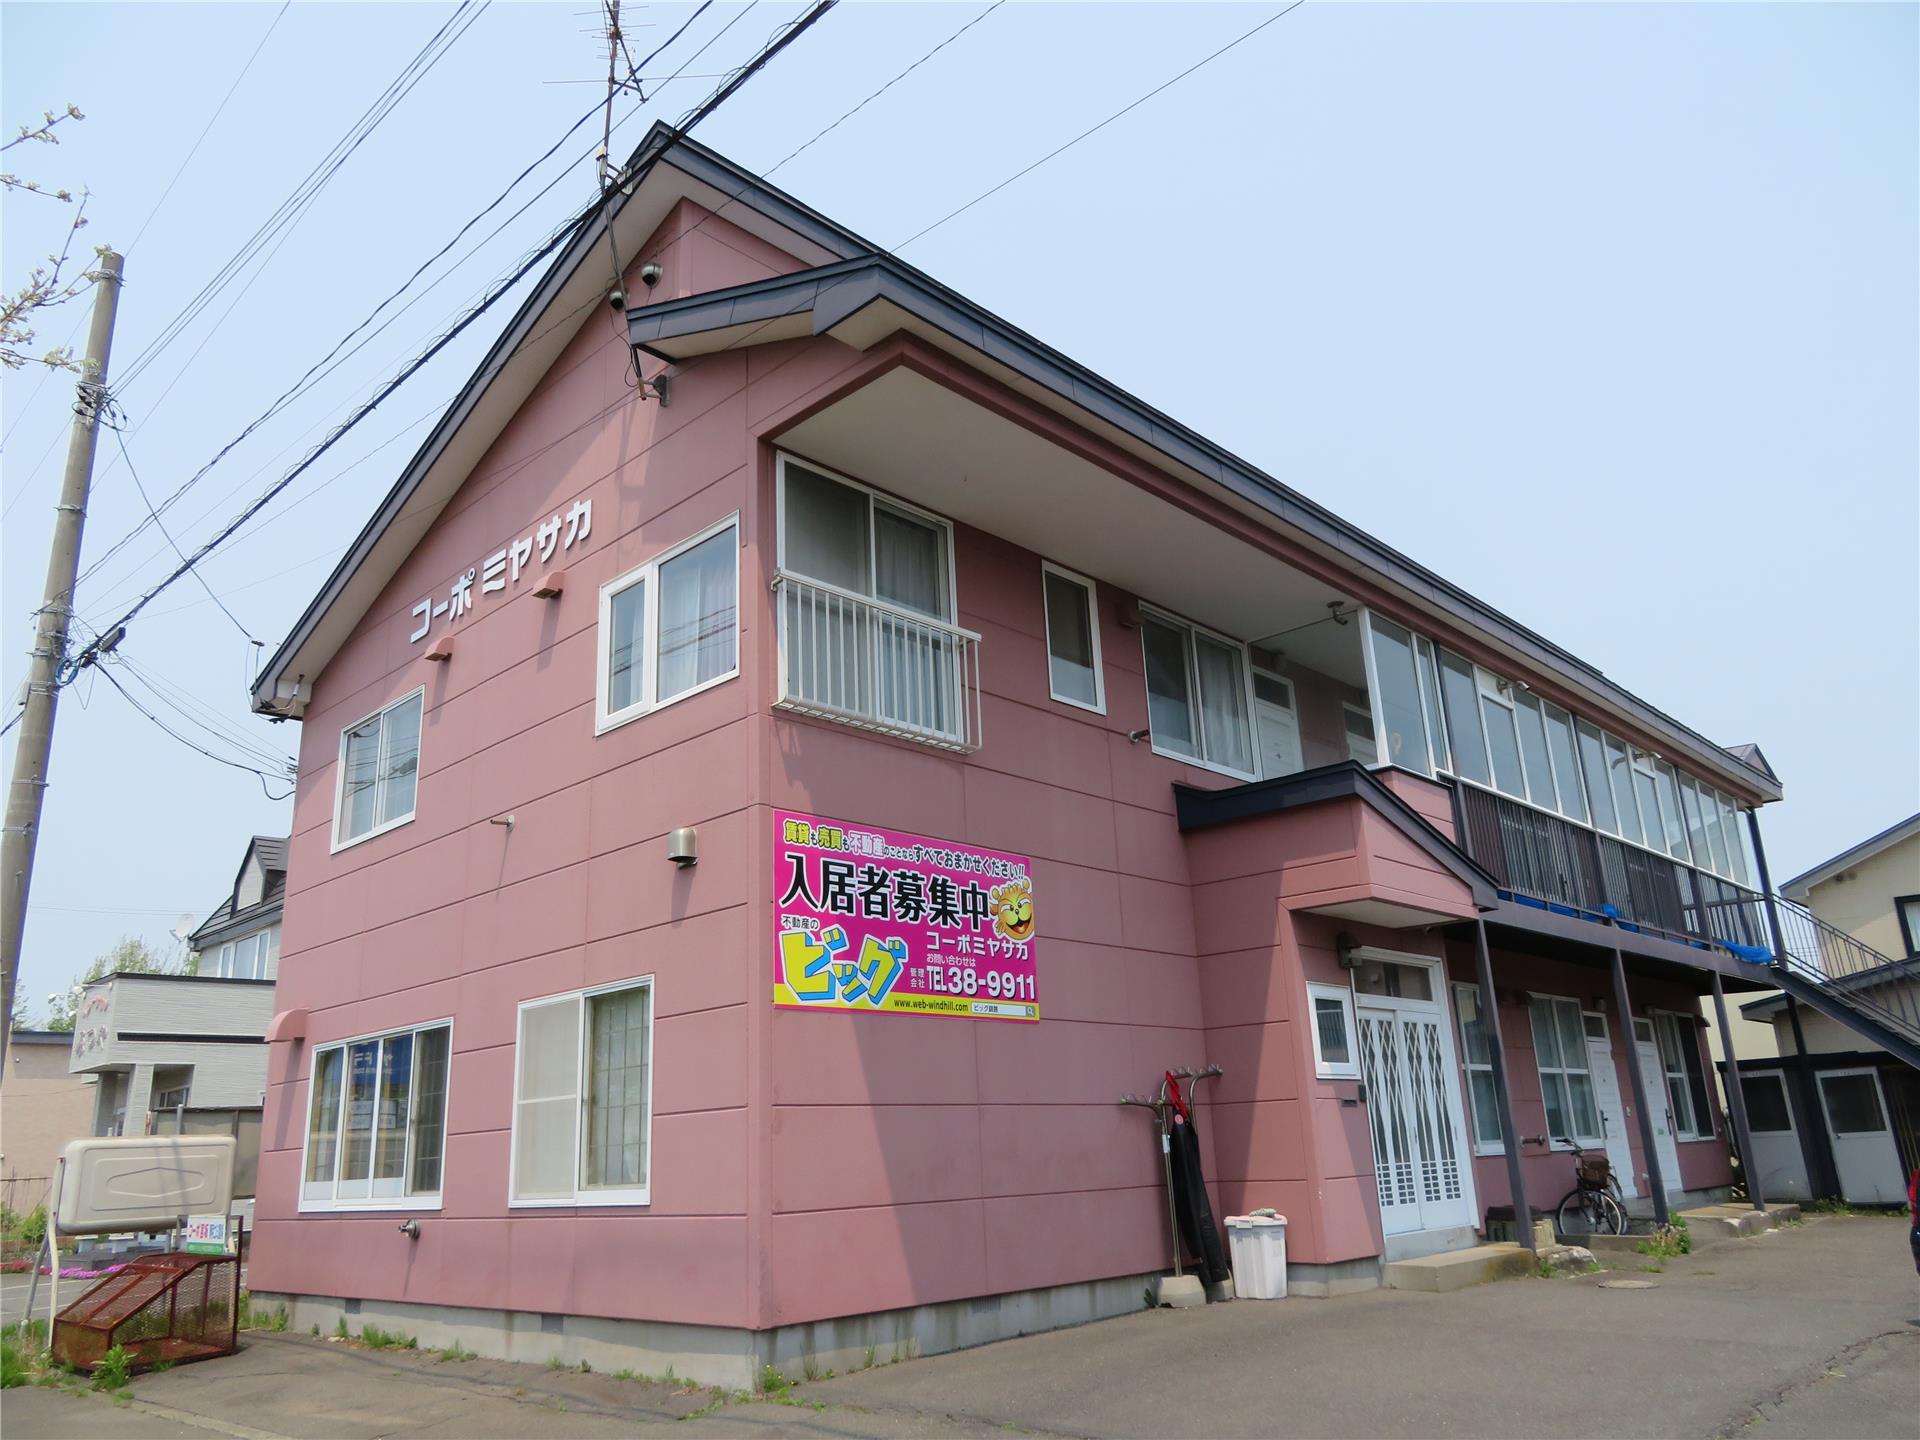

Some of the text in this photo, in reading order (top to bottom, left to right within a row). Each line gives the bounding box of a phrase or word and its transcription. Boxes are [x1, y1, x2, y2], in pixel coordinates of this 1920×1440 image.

[410, 498, 593, 643] コーポミヤサカ
[780, 853, 989, 931] 入居者募集中
[782, 915, 819, 930] 不動産の
[926, 931, 1029, 961] コーポミヤサカ
[782, 926, 908, 1005] ビッグ
[926, 953, 977, 967] お問い合わせは
[910, 967, 925, 978] 管理
[910, 978, 925, 988] 会社
[894, 999, 969, 1012] www.web-windhill.com
